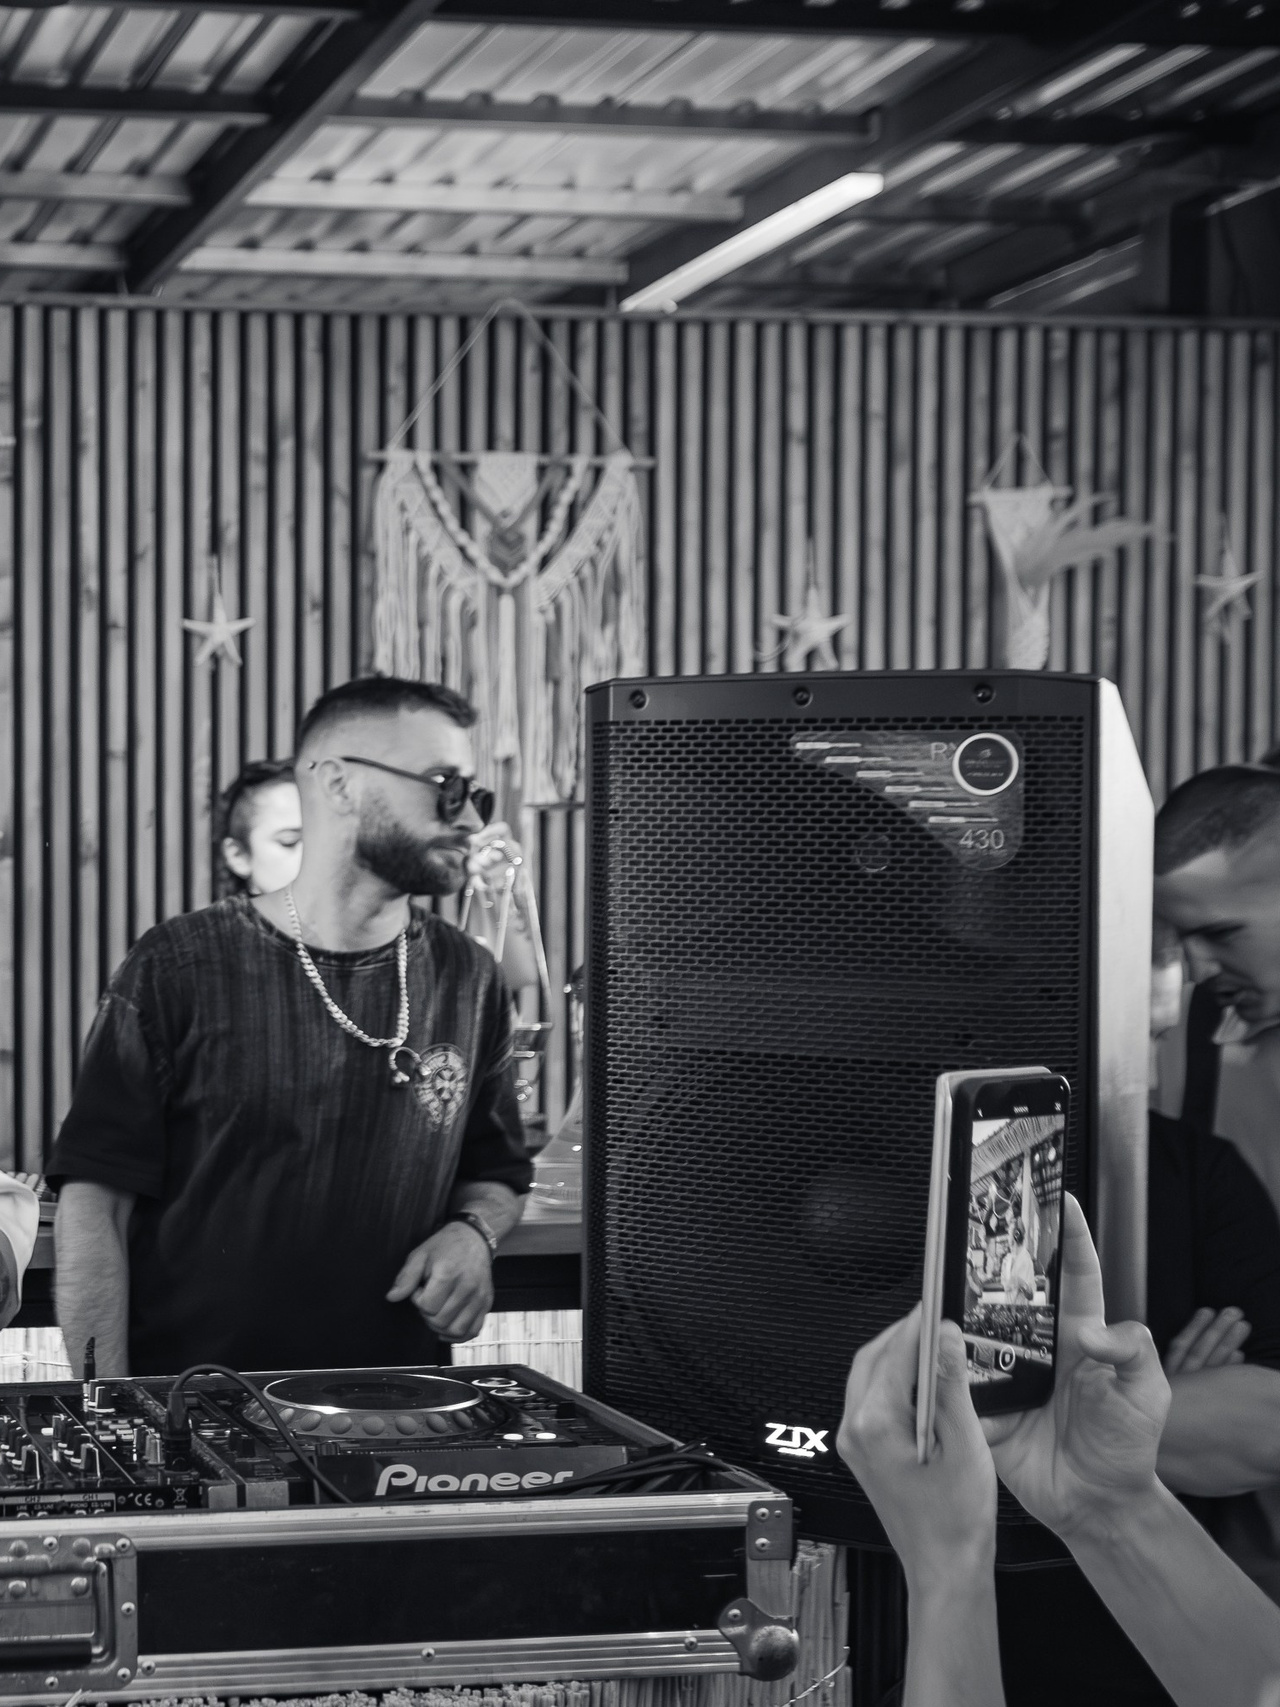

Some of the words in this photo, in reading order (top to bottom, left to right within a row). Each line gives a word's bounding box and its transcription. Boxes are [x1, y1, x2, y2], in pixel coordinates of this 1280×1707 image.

[959, 829, 1005, 850] 430
[375, 1463, 574, 1496] Pioneer
[82, 1493, 99, 1501] CH1
[135, 1493, 152, 1506] CE
